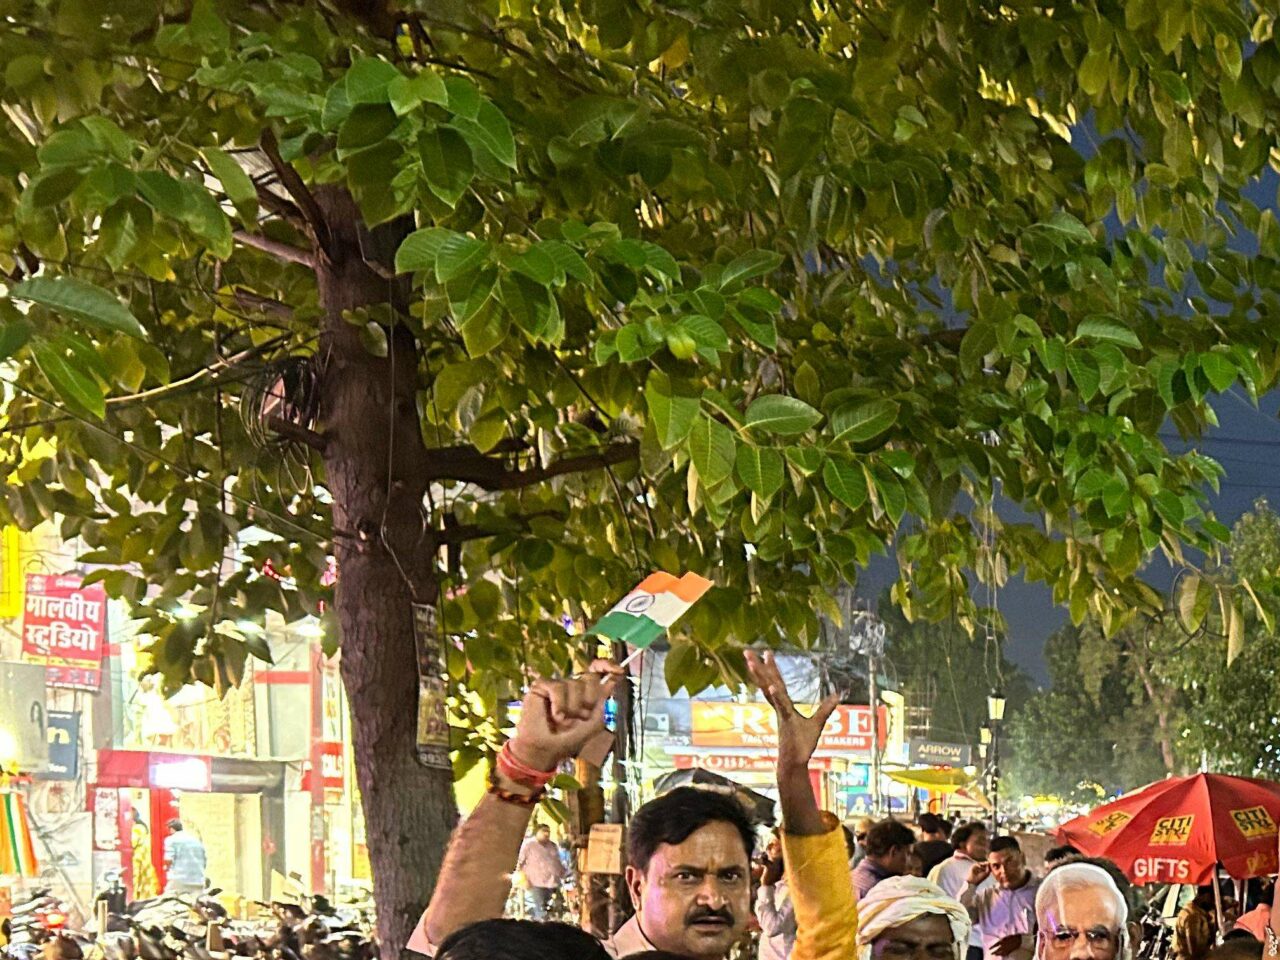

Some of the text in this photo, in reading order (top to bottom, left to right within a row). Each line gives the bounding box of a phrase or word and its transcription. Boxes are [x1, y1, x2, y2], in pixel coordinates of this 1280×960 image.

[26, 592, 101, 623] मालवीय
[731, 704, 875, 736] RBE
[825, 736, 866, 746] MAKERS
[918, 743, 962, 756] ARROW
[1233, 807, 1268, 821] CITI
[1158, 816, 1192, 830] CITI
[1133, 857, 1190, 879] GIFTS
